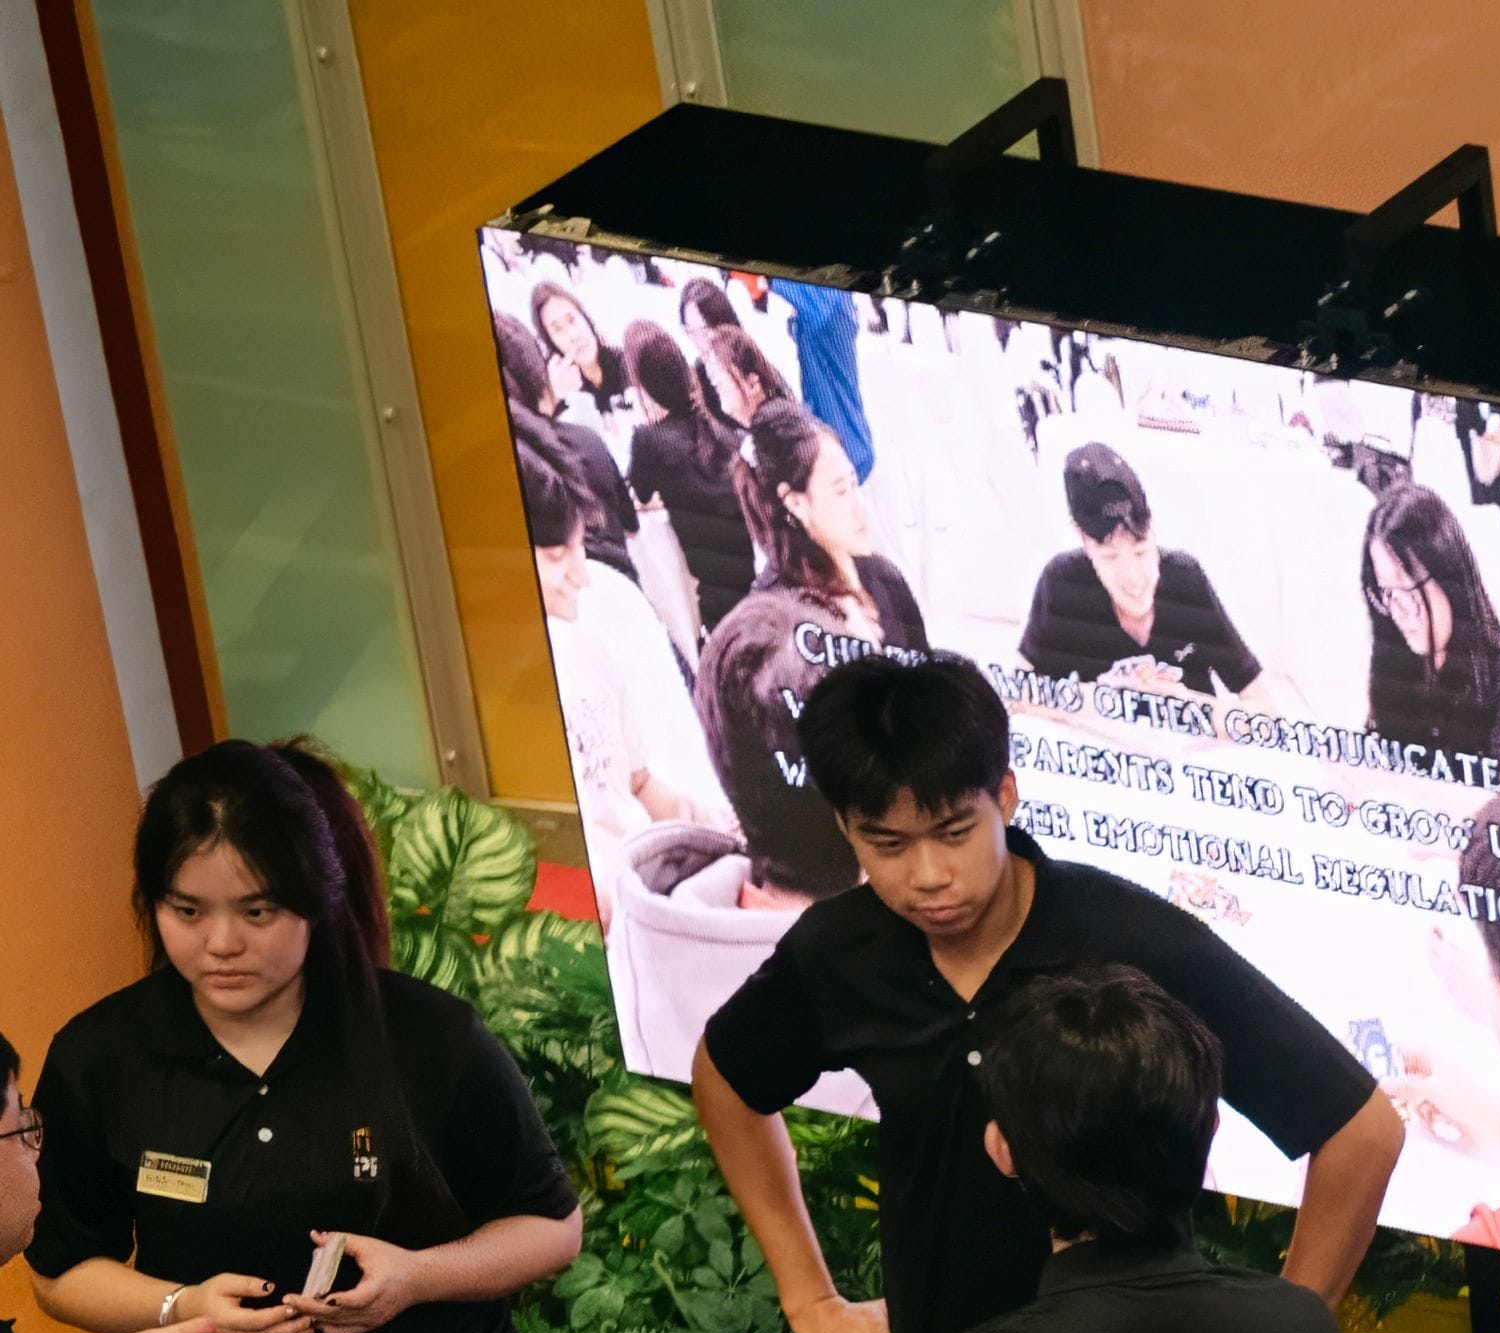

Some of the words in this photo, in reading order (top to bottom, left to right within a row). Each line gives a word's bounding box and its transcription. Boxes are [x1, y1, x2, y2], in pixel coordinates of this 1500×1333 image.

[988, 663, 1083, 713] WHO
[1094, 685, 1218, 738] OFTEN
[1008, 732, 1175, 795] PARENTS
[1183, 765, 1285, 815] TEND
[1293, 785, 1351, 828] TO
[1358, 800, 1475, 852] GROW
[1083, 808, 1304, 885] EMOTIONAL
